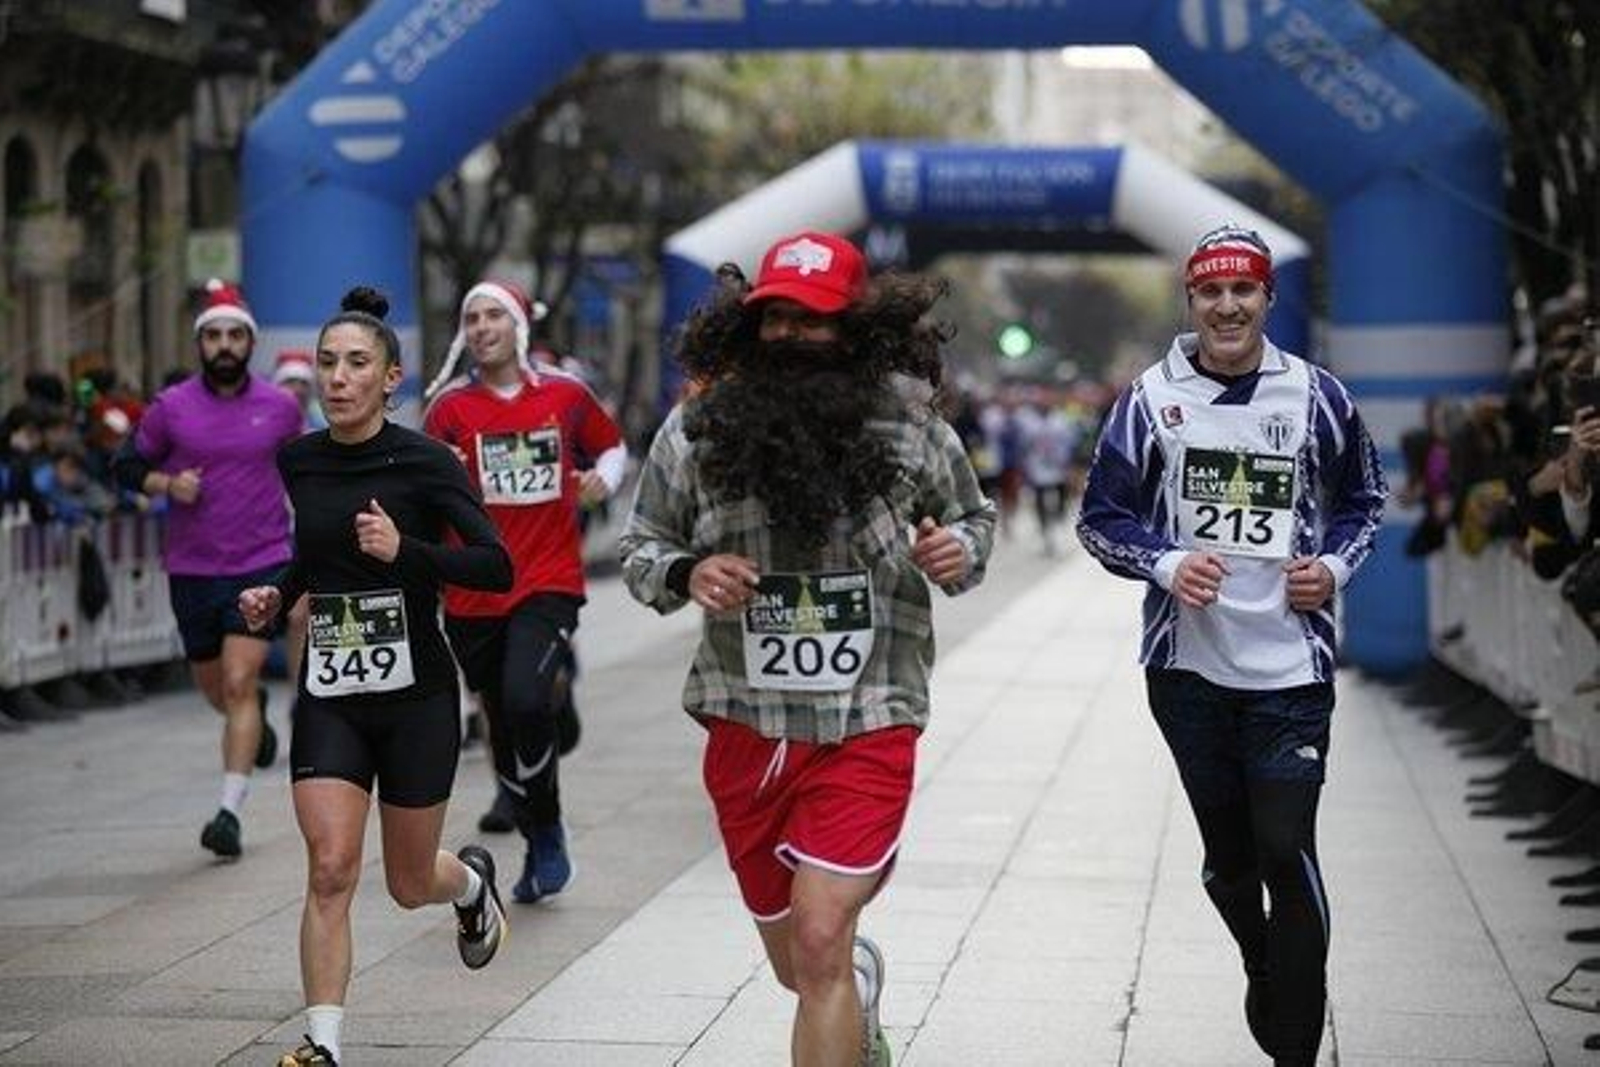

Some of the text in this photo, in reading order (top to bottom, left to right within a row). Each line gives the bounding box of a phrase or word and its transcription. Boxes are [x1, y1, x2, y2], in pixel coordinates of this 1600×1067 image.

[488, 465, 556, 494] 1122
[1187, 465, 1219, 480] SAN
[1187, 480, 1265, 495] SILVESTRE
[1193, 505, 1274, 546] 213
[749, 603, 838, 621] SILVESTRE
[750, 593, 784, 609] SAN
[317, 646, 398, 686] 349
[759, 633, 861, 678] 206
